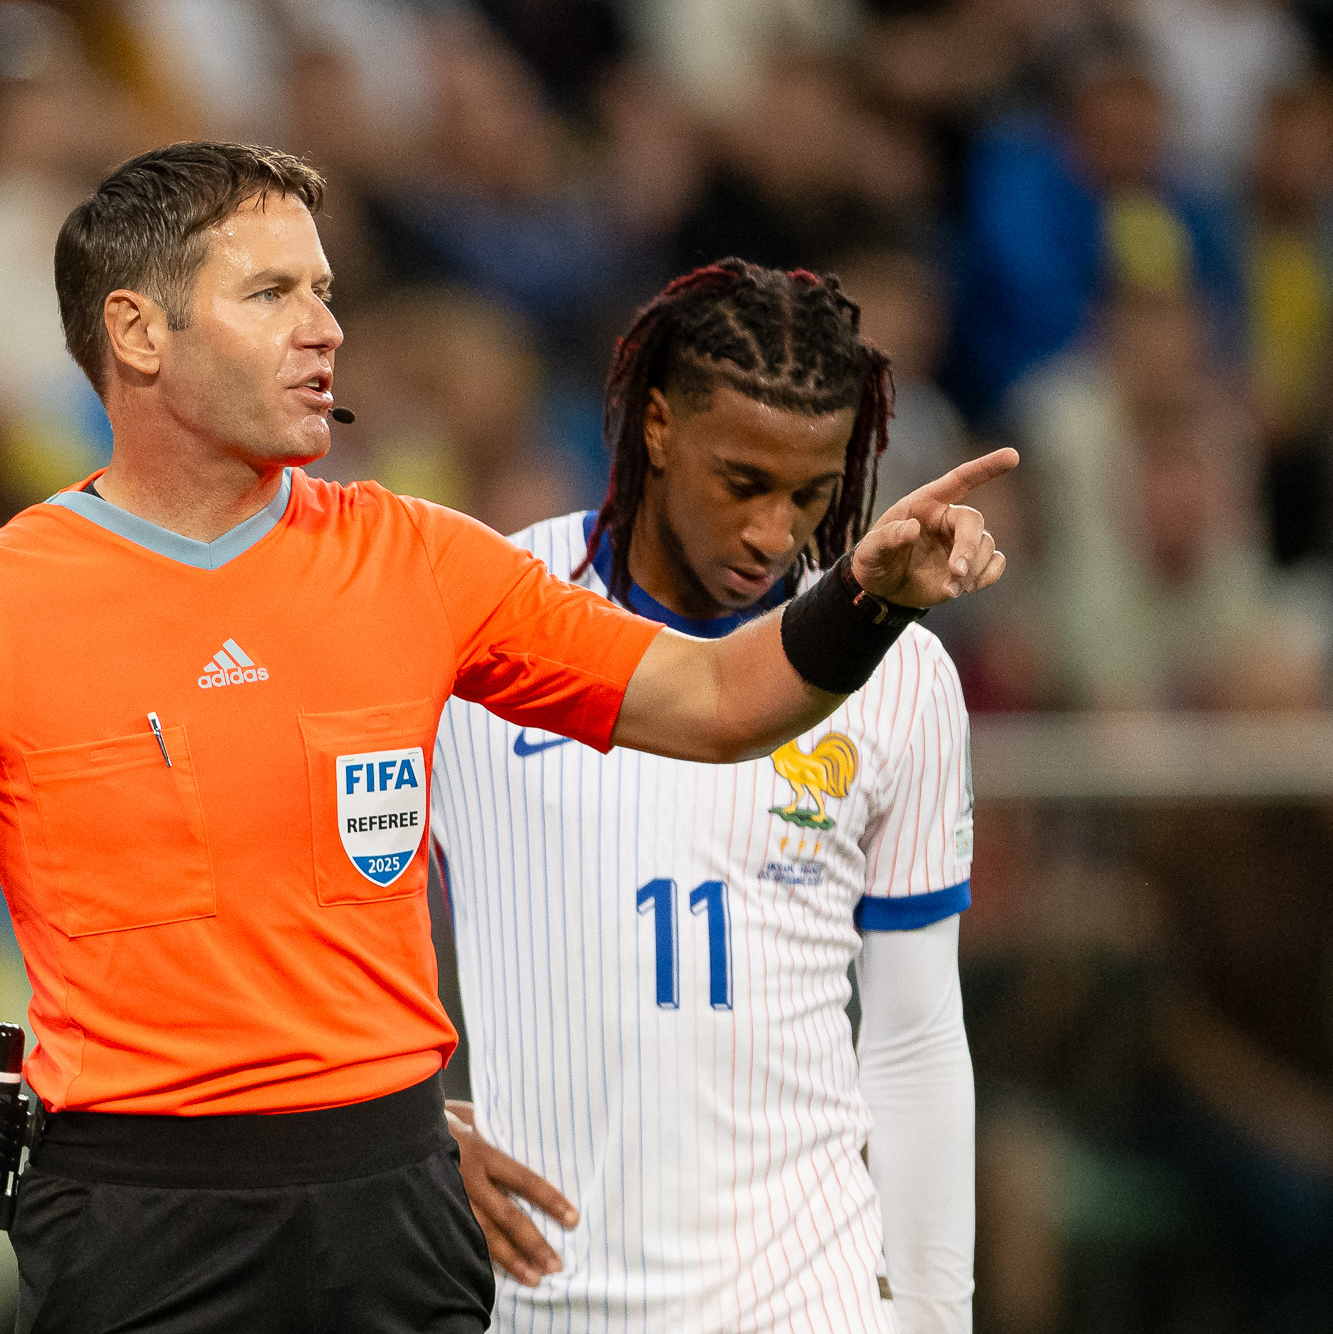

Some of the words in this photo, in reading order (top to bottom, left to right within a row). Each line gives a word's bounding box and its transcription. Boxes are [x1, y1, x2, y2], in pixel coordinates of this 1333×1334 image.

[197, 666, 270, 689] adidas
[345, 758, 419, 795] FIFA
[347, 810, 419, 834] REFEREE
[368, 856, 401, 874] 2025
[636, 876, 733, 1011] 11
